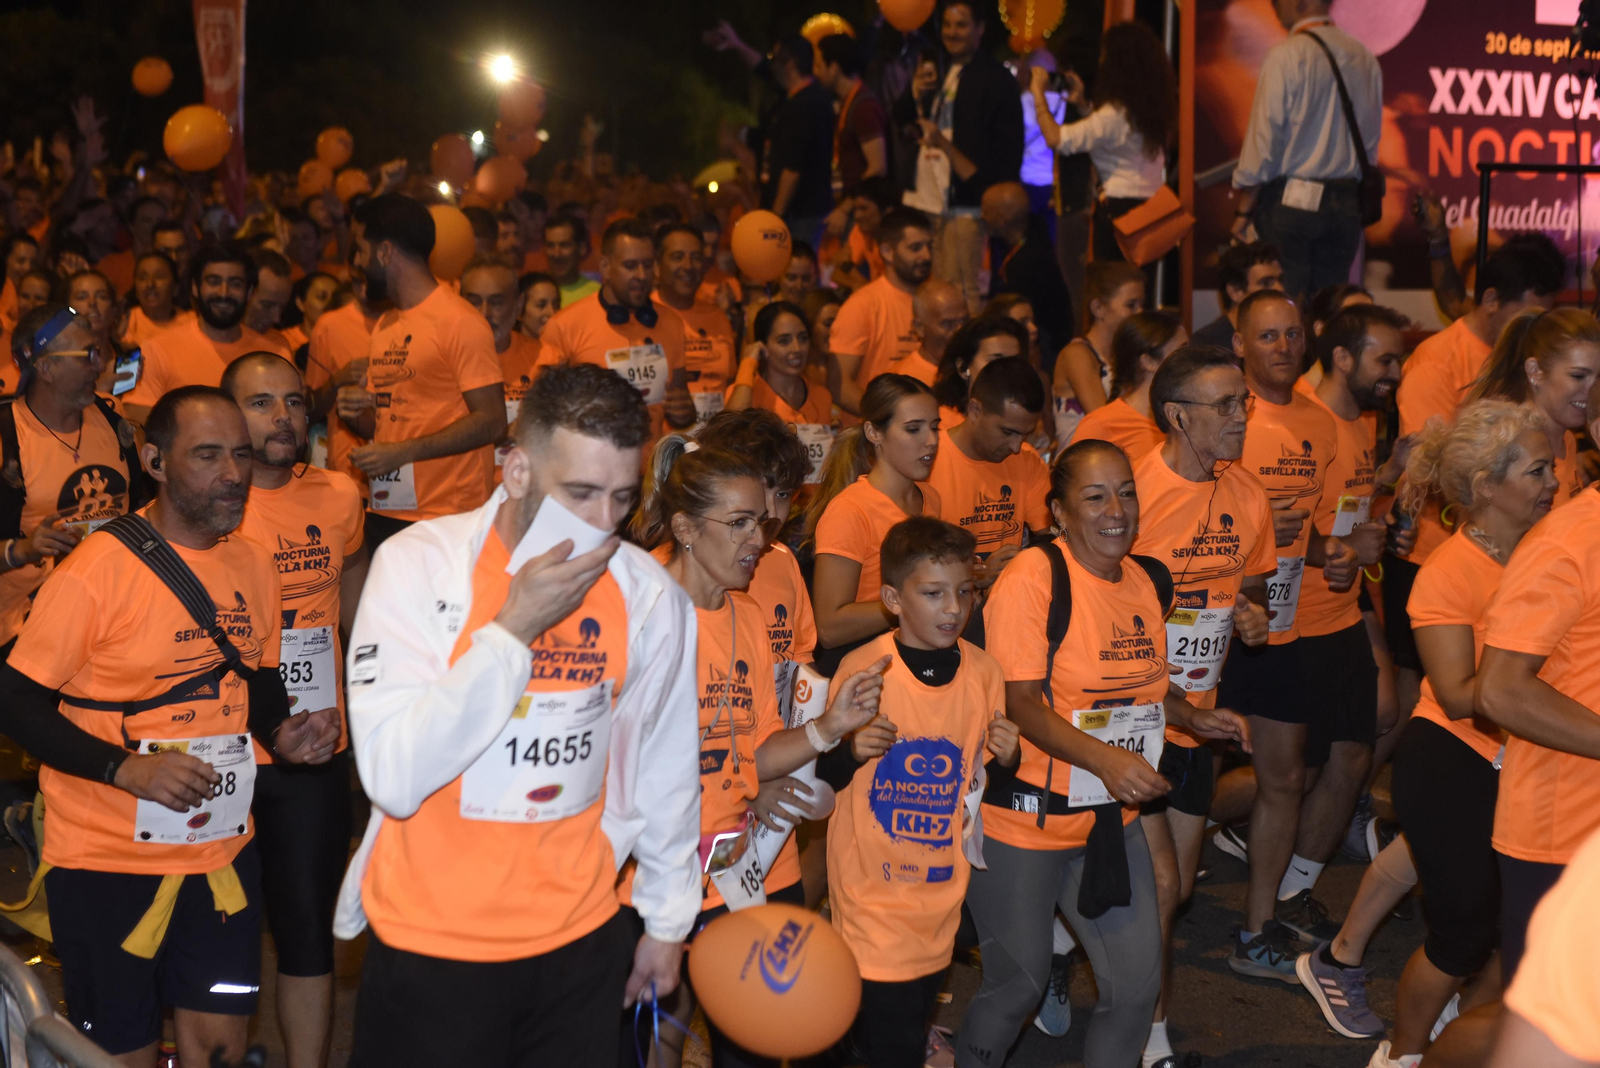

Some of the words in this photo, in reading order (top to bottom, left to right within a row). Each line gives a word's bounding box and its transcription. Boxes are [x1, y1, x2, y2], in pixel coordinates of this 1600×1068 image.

[1485, 31, 1507, 54] 30
[1509, 34, 1532, 56] de
[1429, 66, 1552, 118] XXXIV
[628, 365, 656, 382] 9145
[1277, 457, 1317, 467] NOCTURNA
[1259, 466, 1296, 477] SEVILLA
[974, 503, 1015, 513] NOCTURNA
[959, 514, 993, 526] SEVILLA
[1192, 534, 1240, 545] NOCTURNA
[274, 546, 330, 561] NOCTURNA
[1172, 547, 1214, 558] SEVILLA
[1268, 583, 1291, 600] 678
[1111, 637, 1154, 649] NOCTURNA
[1175, 635, 1227, 657] 21913
[1099, 650, 1134, 661] SEVILLA
[505, 731, 593, 768] 14655
[875, 778, 893, 790] LA
[897, 813, 950, 836] KH-7
